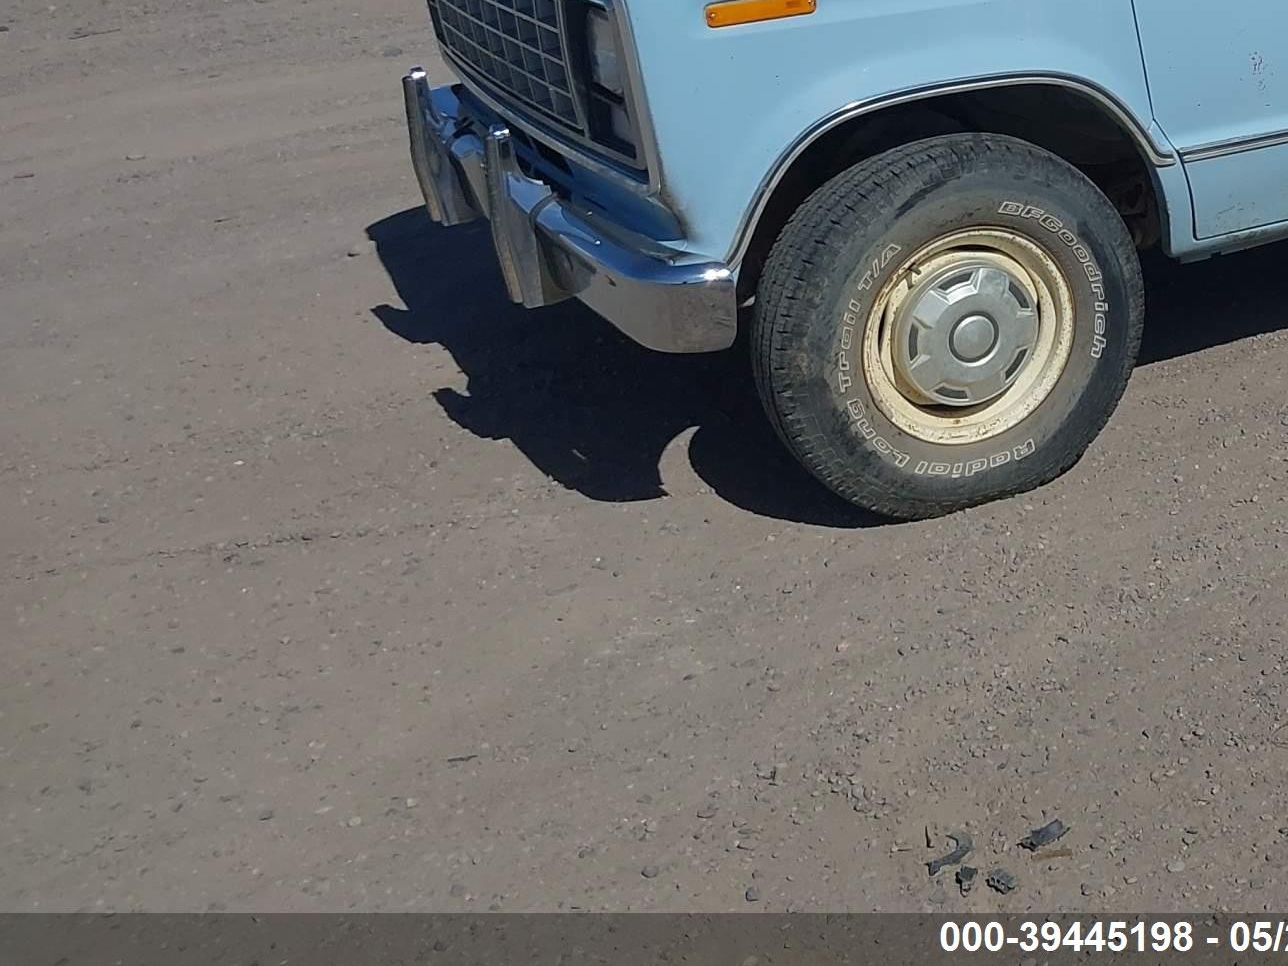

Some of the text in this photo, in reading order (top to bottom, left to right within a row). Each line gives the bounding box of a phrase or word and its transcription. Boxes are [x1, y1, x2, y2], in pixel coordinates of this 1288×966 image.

[838, 243, 1036, 478] Radial Long Trail T/A
[997, 201, 1109, 359] BFGoodrich
